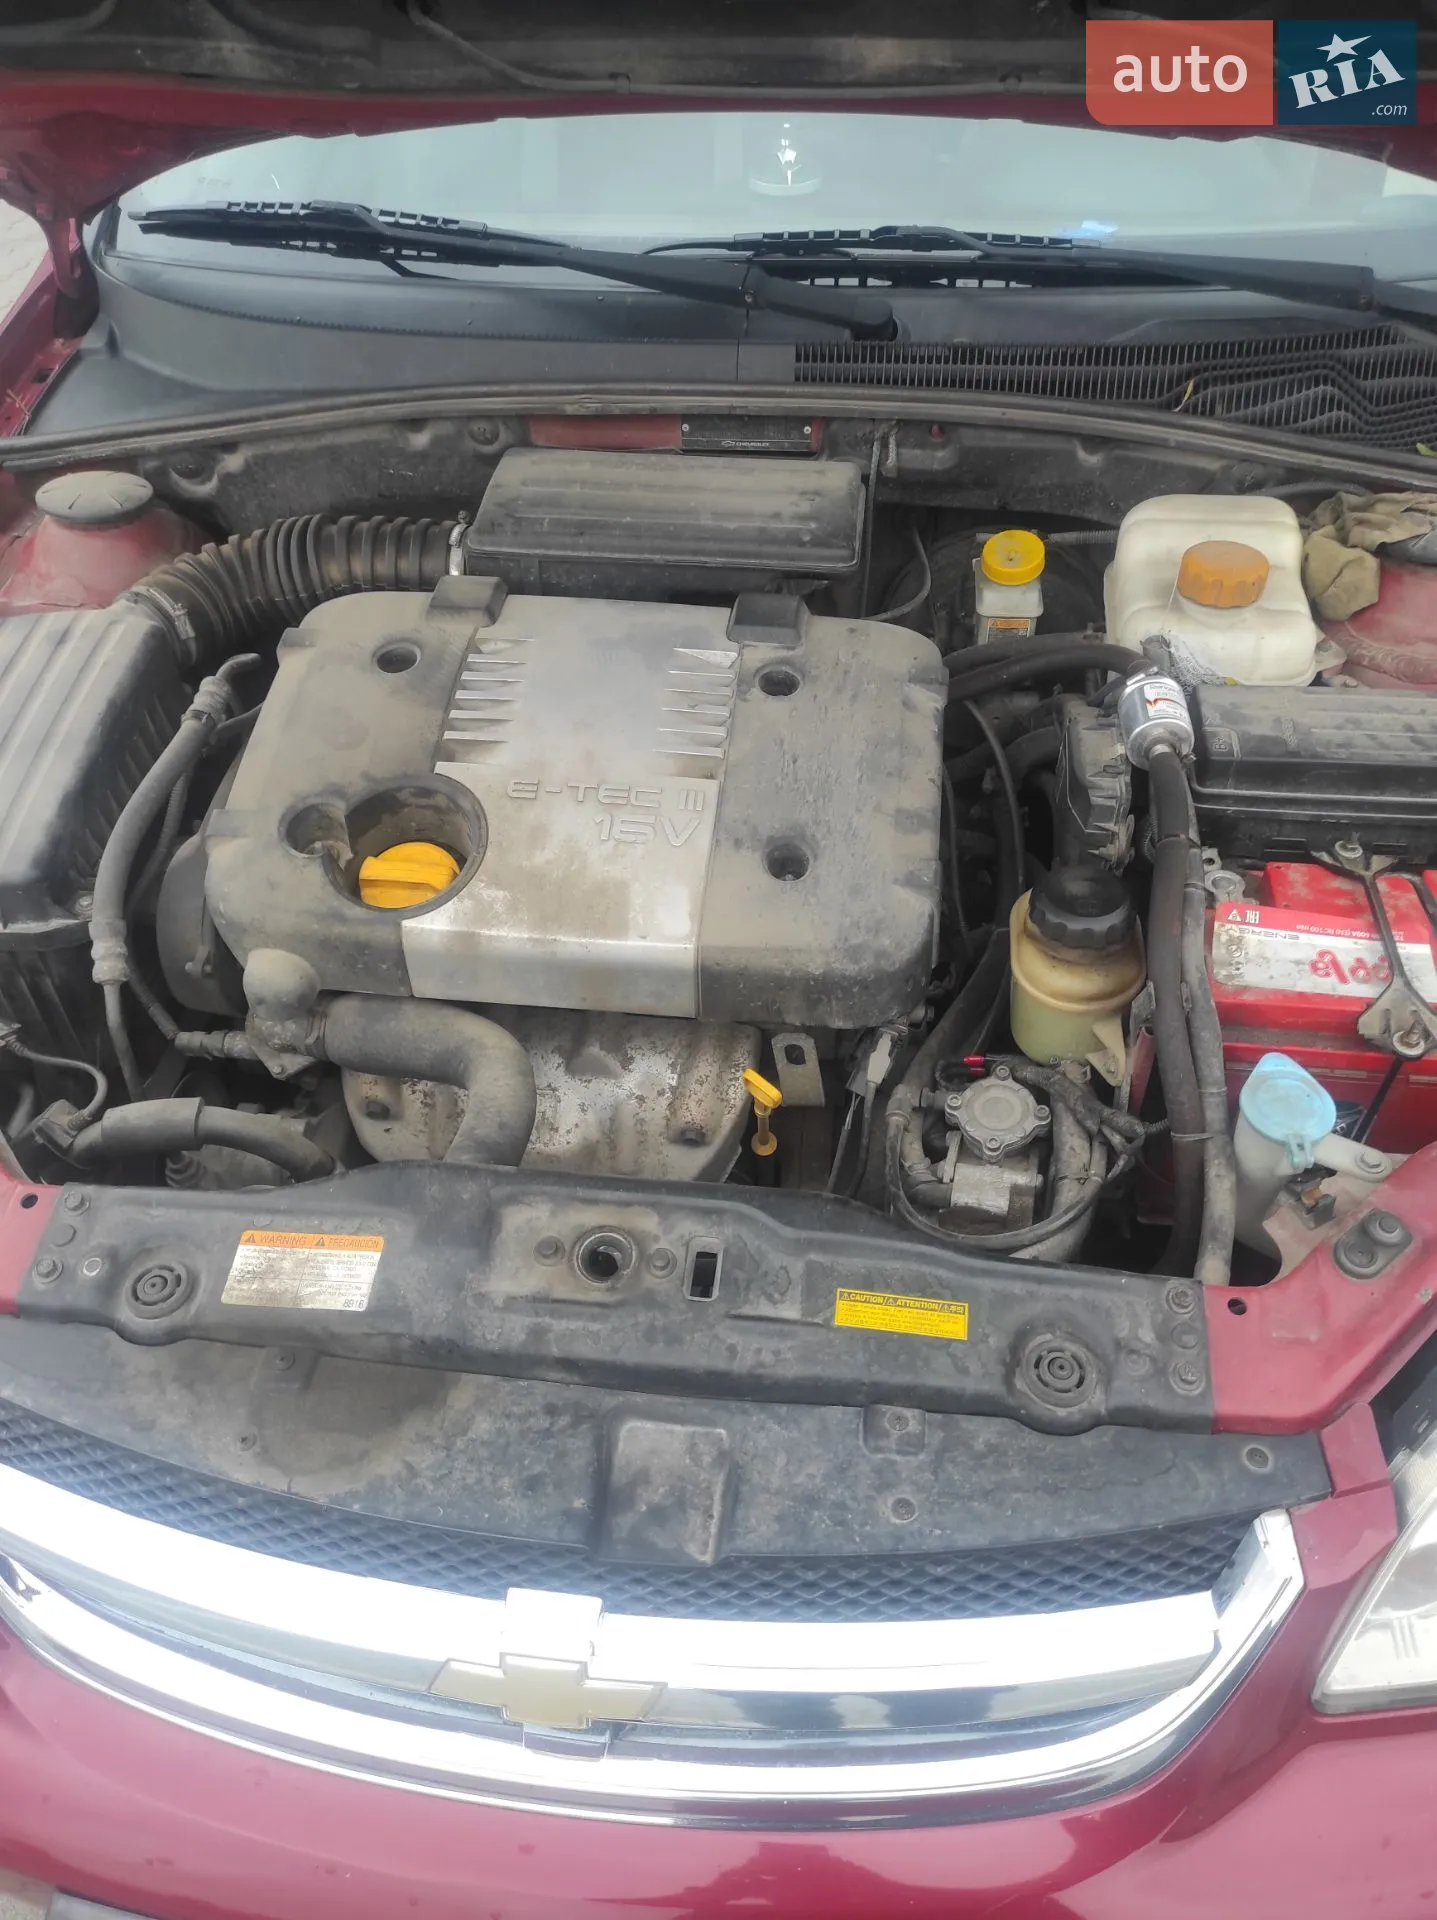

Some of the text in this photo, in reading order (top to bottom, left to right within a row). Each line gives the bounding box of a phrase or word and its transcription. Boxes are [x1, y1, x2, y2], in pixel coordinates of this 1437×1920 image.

[506, 779, 662, 808] E-TEC
[593, 813, 701, 847] 16V
[259, 1234, 309, 1245] WARNING
